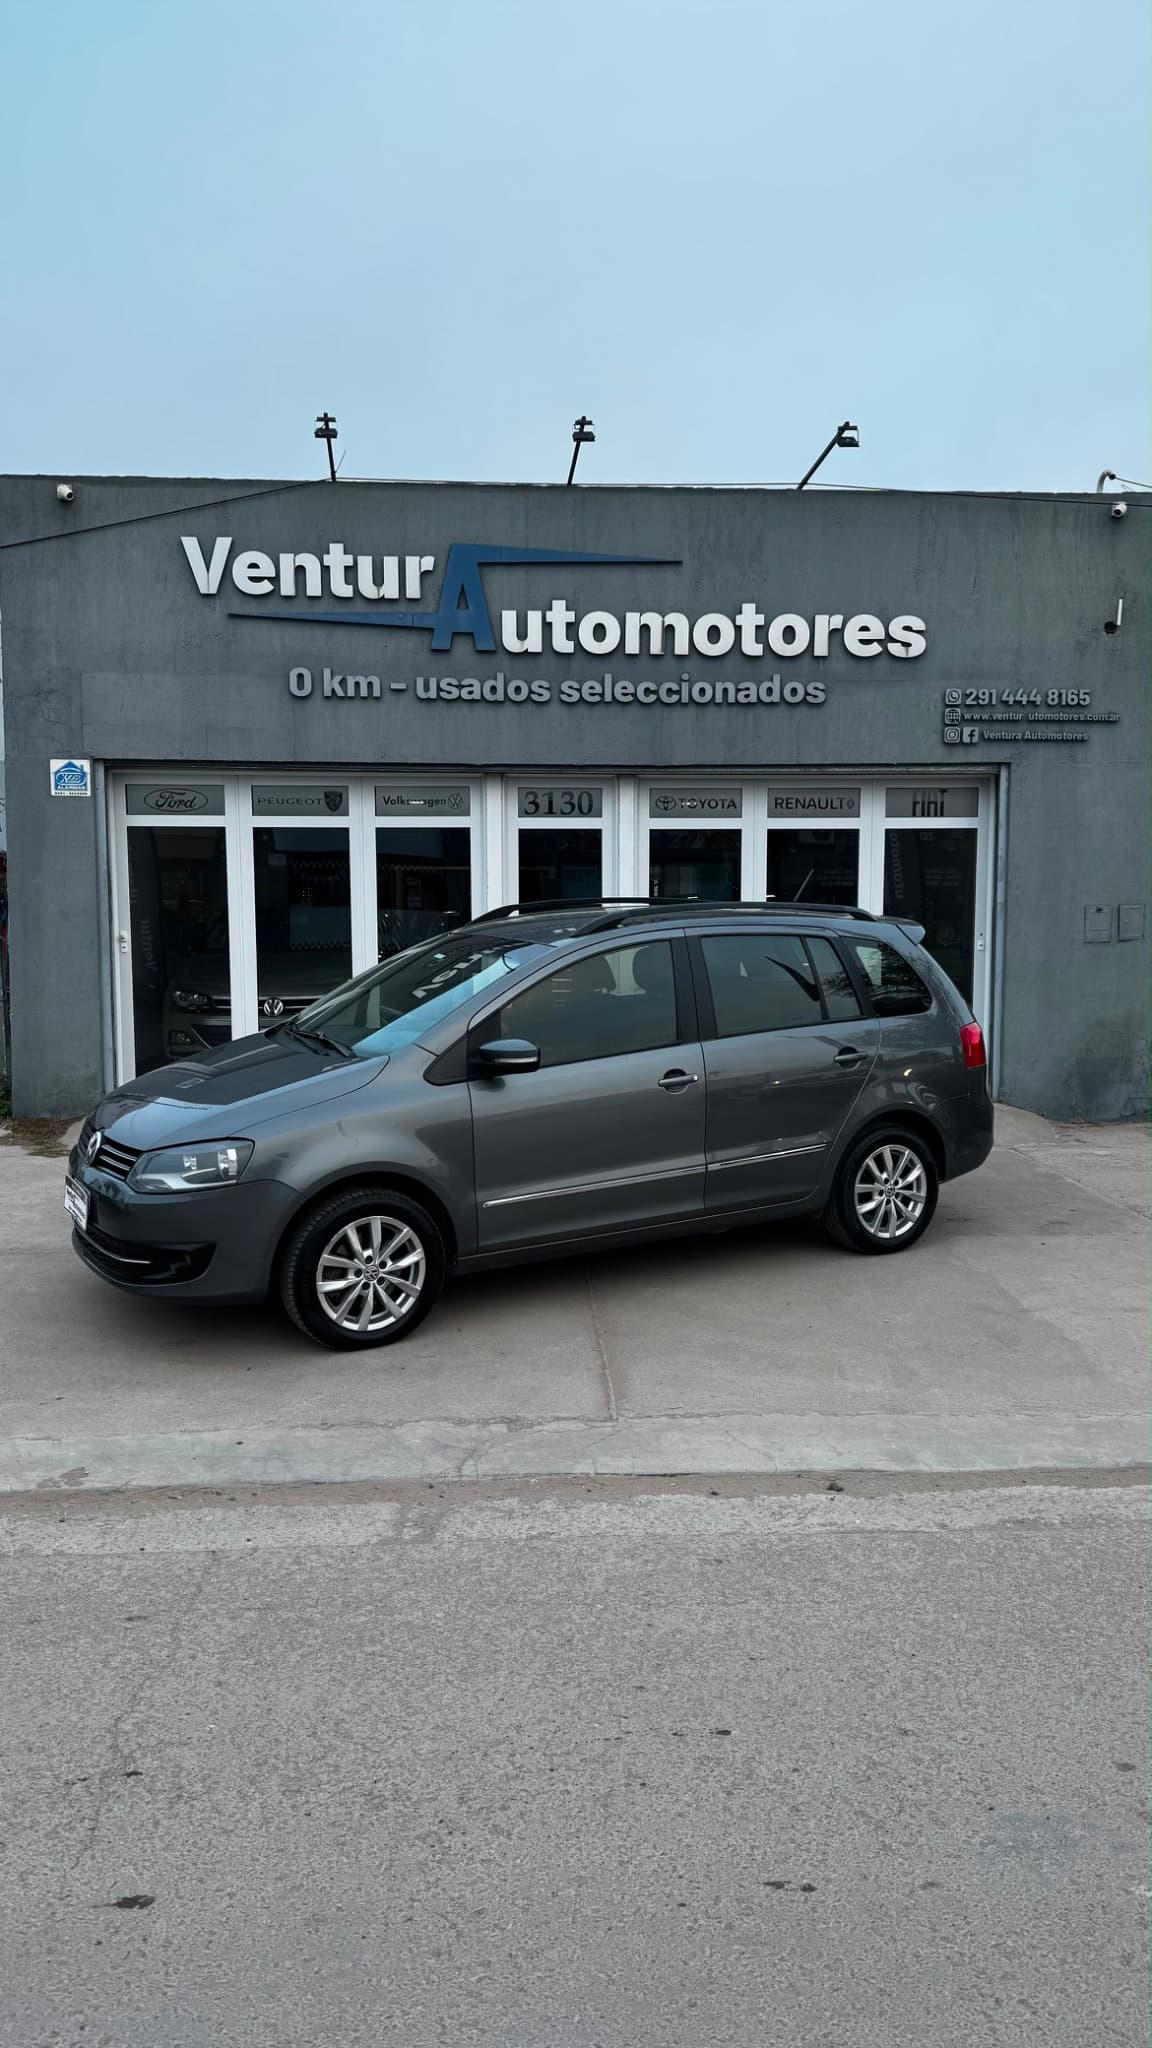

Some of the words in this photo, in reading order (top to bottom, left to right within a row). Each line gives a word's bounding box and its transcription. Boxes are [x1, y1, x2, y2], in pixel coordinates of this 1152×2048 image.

[289, 667, 312, 697] 0
[323, 667, 381, 697] km
[416, 672, 550, 702] usados
[559, 673, 826, 704] seleccionados
[965, 688, 996, 705] 291
[1001, 688, 1041, 705] 444
[1047, 689, 1091, 706] 8165
[983, 730, 1021, 740] Ventura
[1024, 730, 1089, 741] Automotores
[155, 791, 197, 808] Ford
[257, 797, 322, 805] PEUGEOT
[524, 791, 593, 815] 3130
[678, 798, 737, 809] TOYOTA
[774, 797, 848, 810] RENAULT
